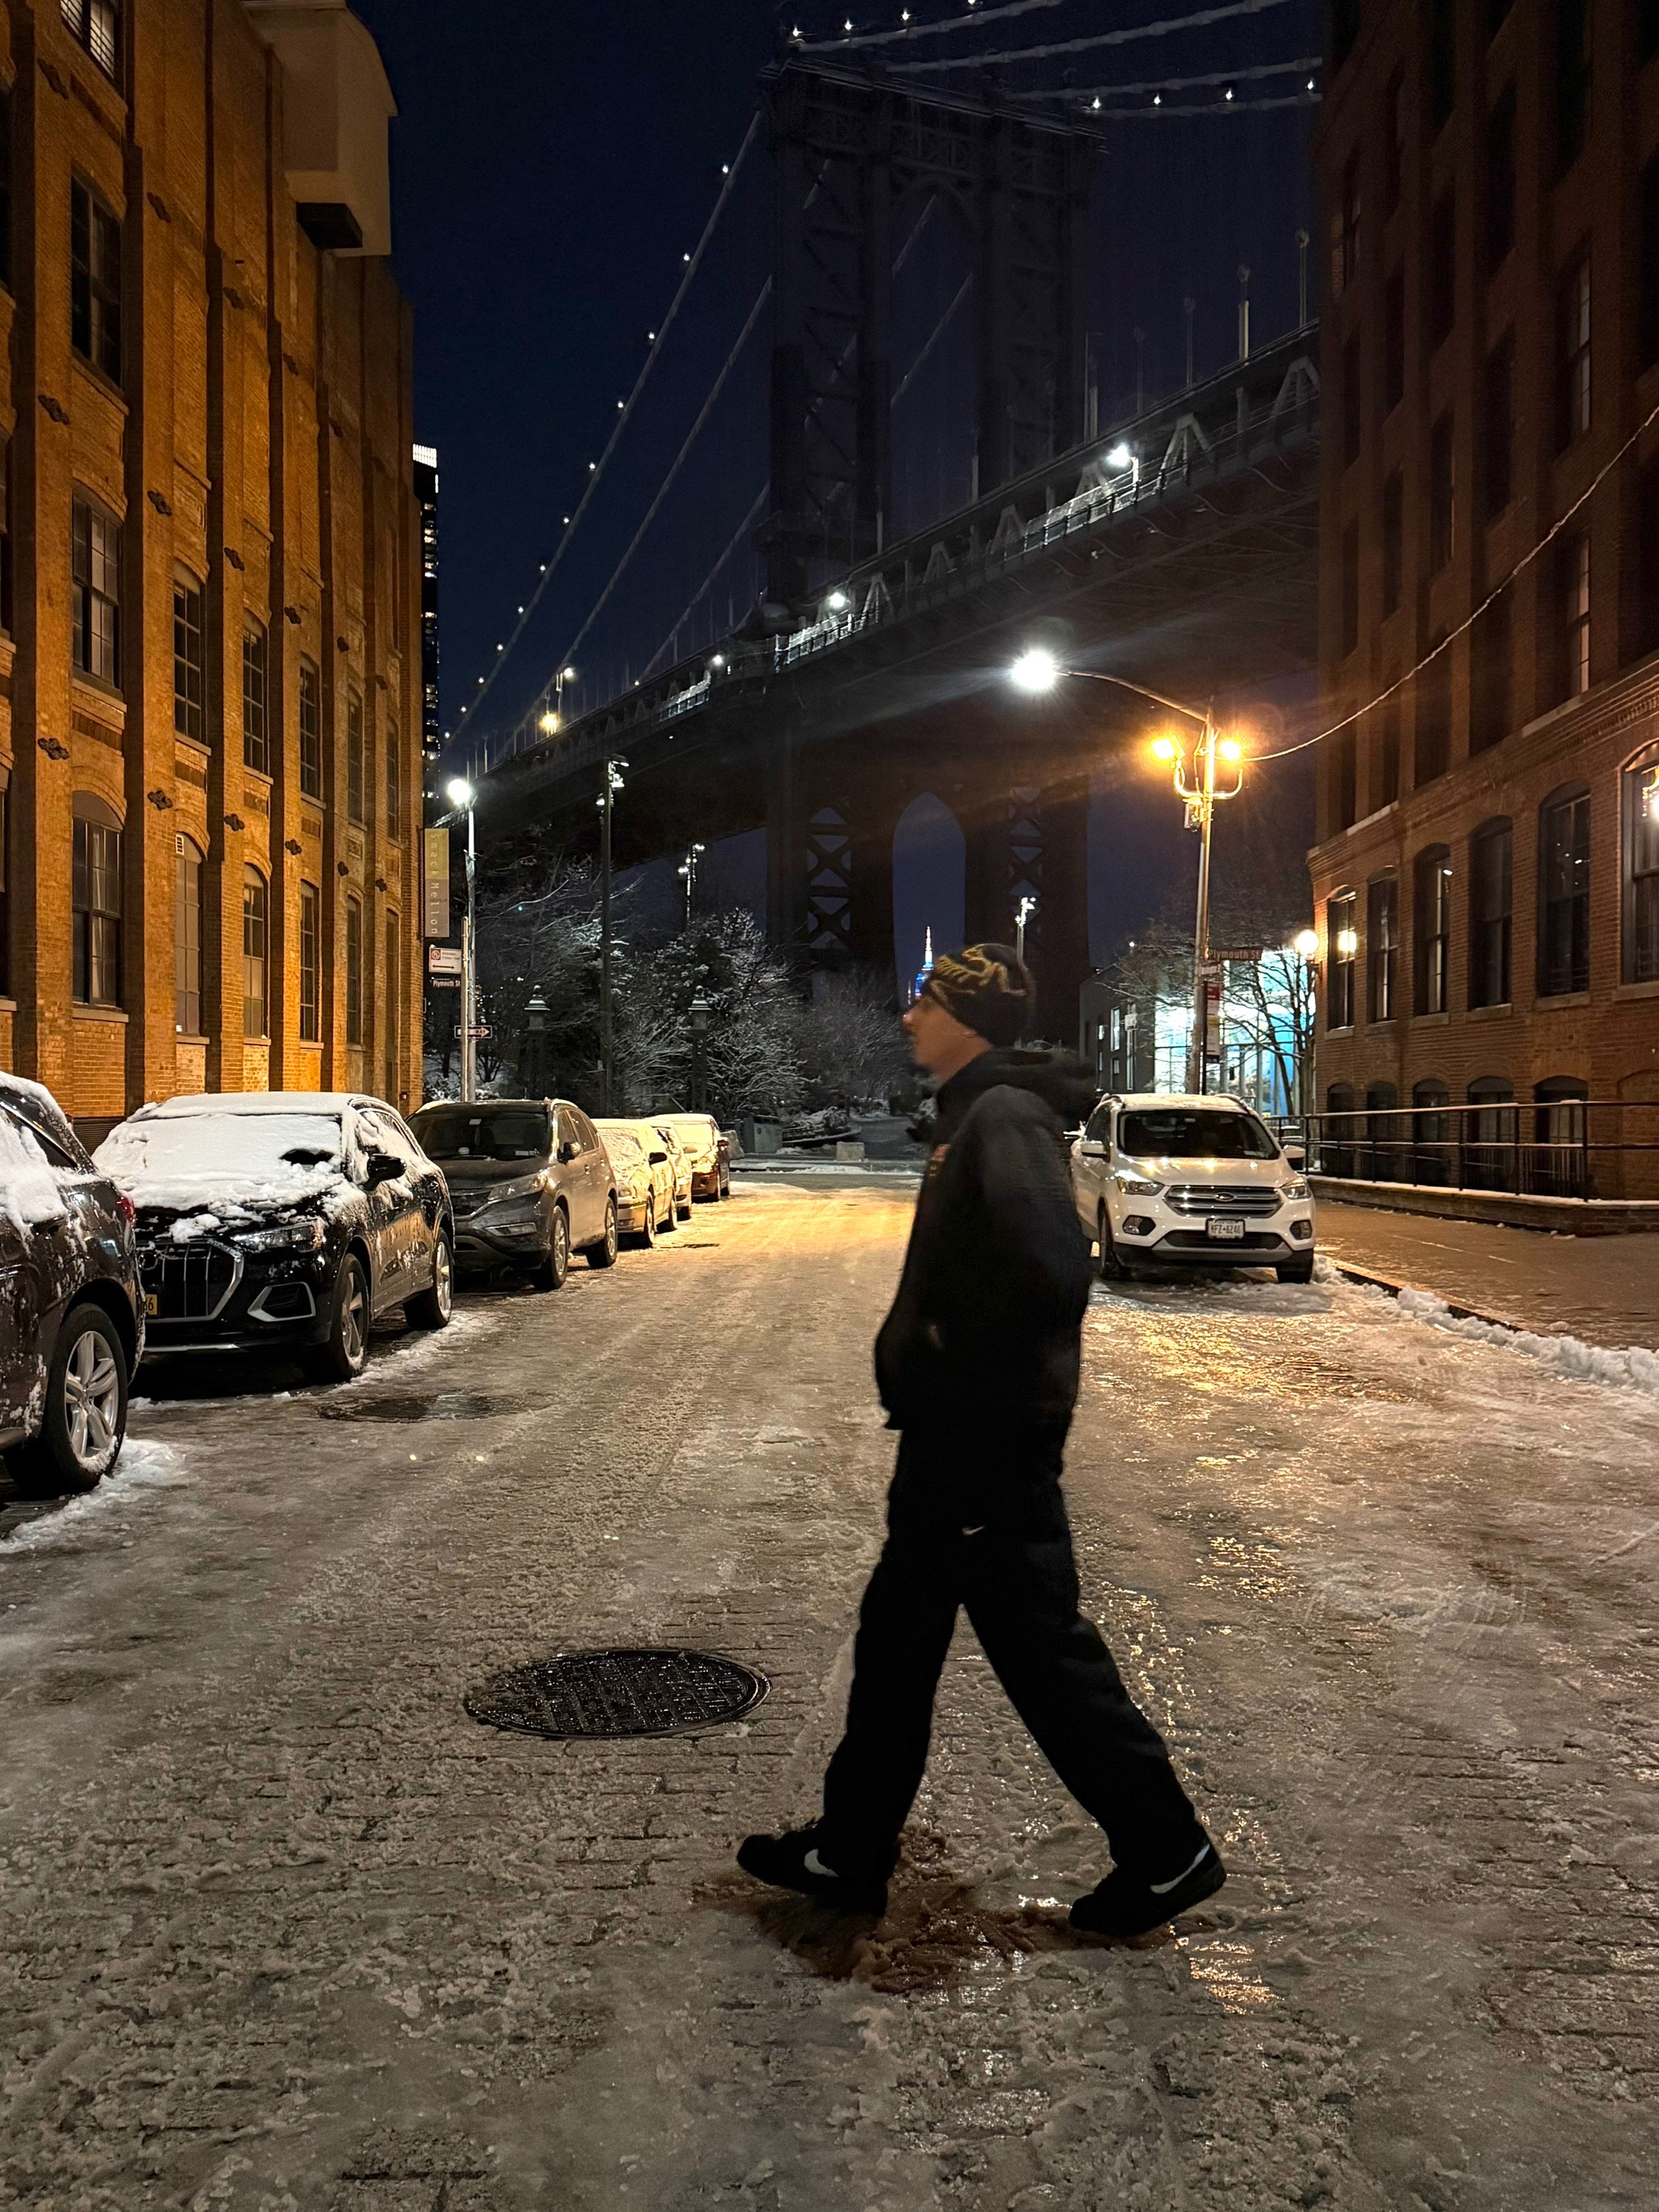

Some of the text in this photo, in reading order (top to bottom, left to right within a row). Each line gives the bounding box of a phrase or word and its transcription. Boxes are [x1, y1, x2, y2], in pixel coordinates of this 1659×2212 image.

[430, 833, 439, 934] Smack Mellon
[1209, 949, 1260, 962] Plymouth St
